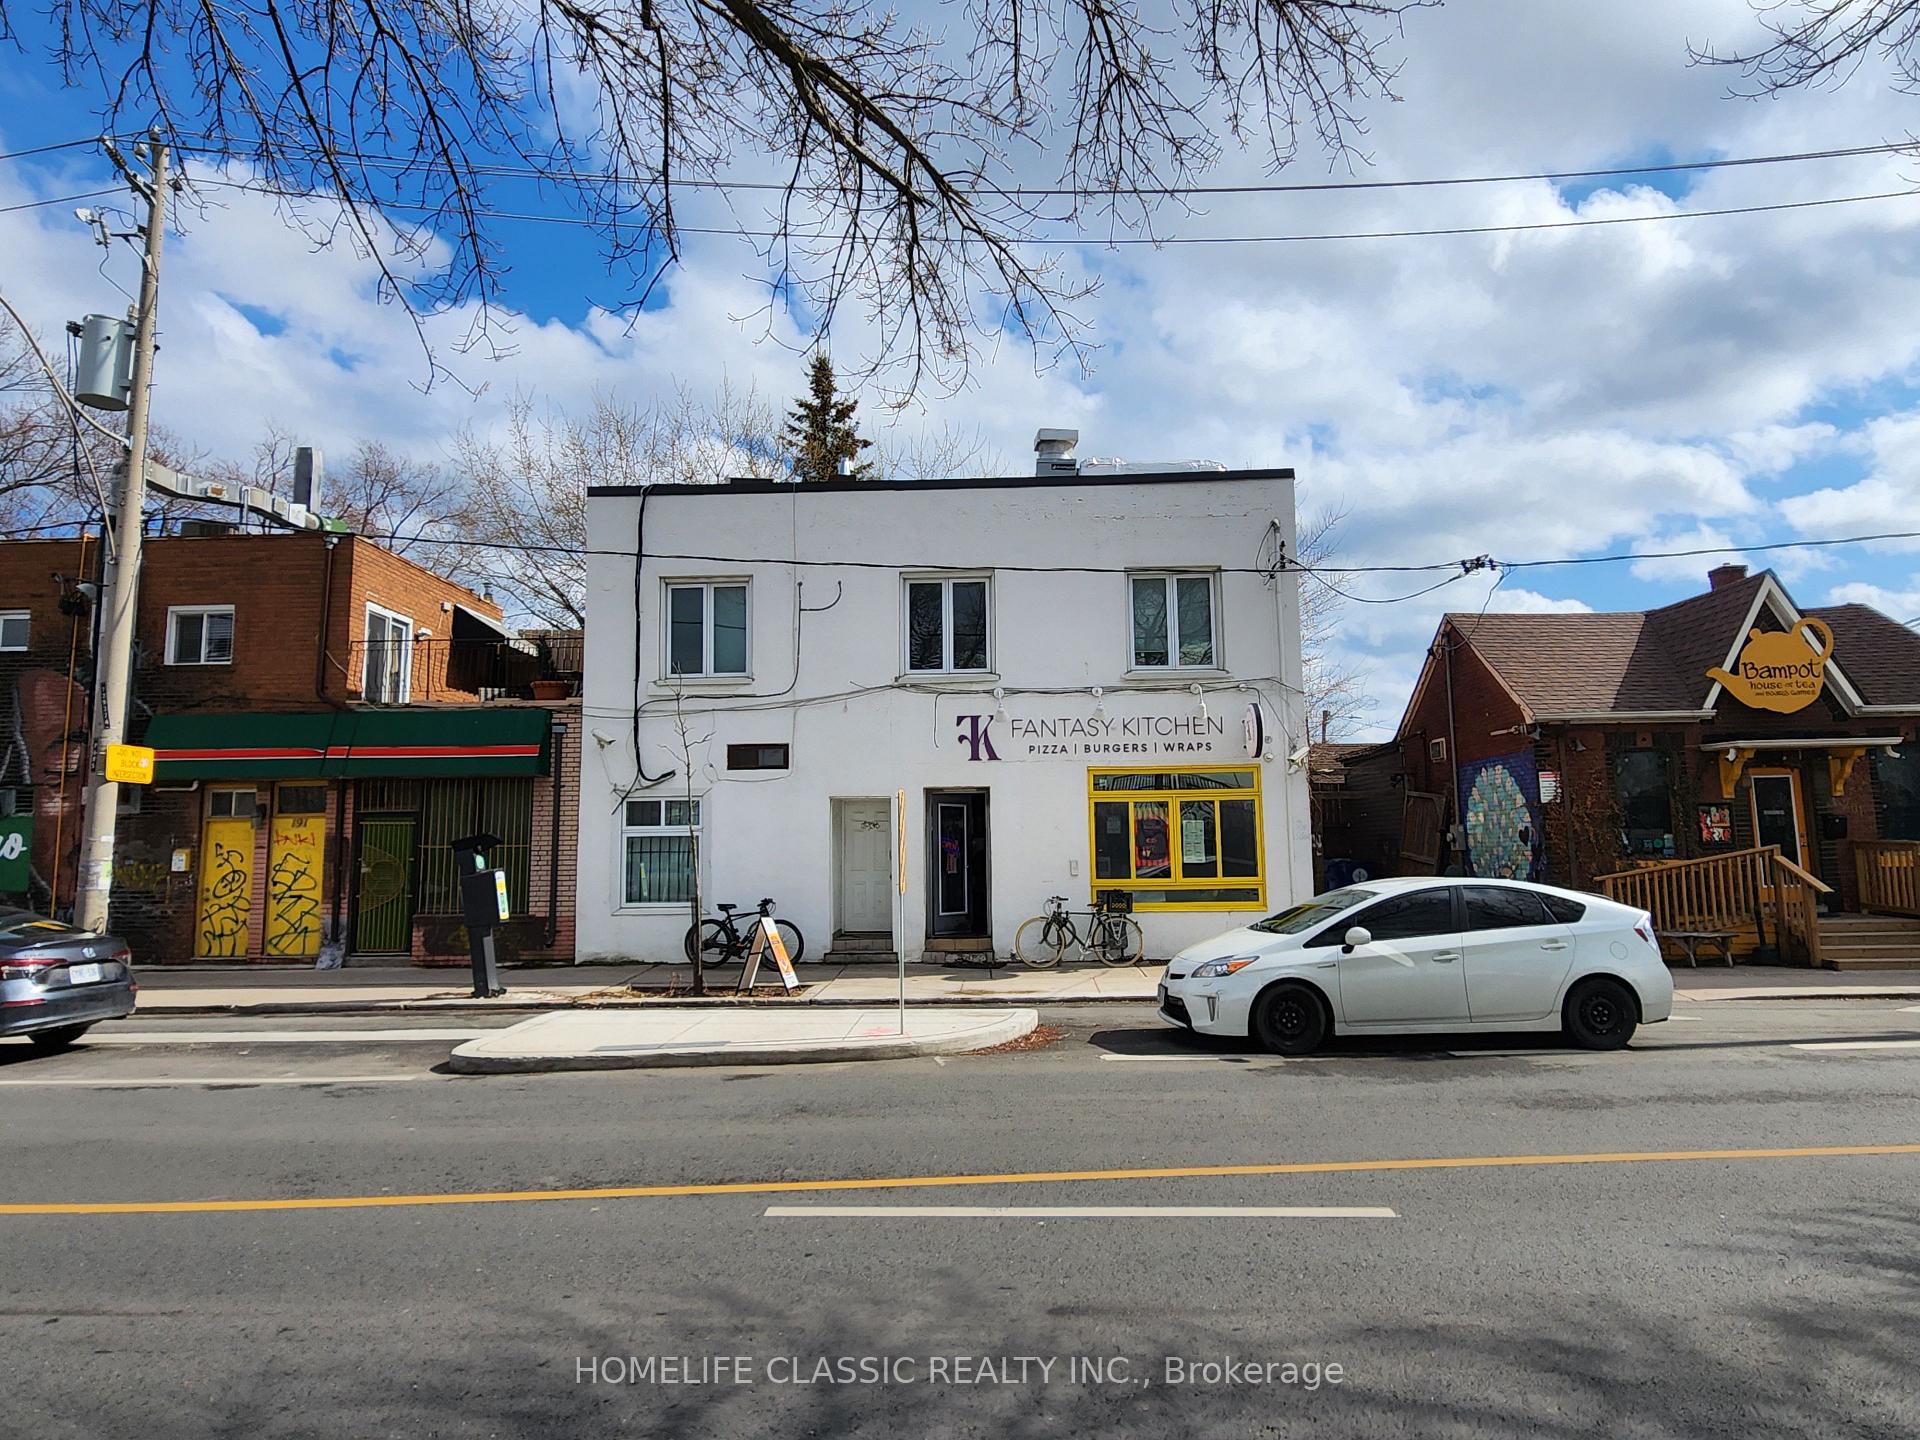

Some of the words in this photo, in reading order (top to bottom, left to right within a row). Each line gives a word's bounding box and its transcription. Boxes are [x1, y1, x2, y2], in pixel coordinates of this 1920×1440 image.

[1741, 658, 1821, 679] Bampot
[1750, 681, 1783, 690] house
[1794, 681, 1816, 689] tea
[1011, 718, 1114, 738] FANTASY
[1122, 716, 1223, 736] KITCHEN
[1029, 745, 1068, 754] PIZZA
[1084, 743, 1148, 753] BURGERS
[1163, 742, 1212, 752] WRAPS
[292, 817, 308, 828] 191
